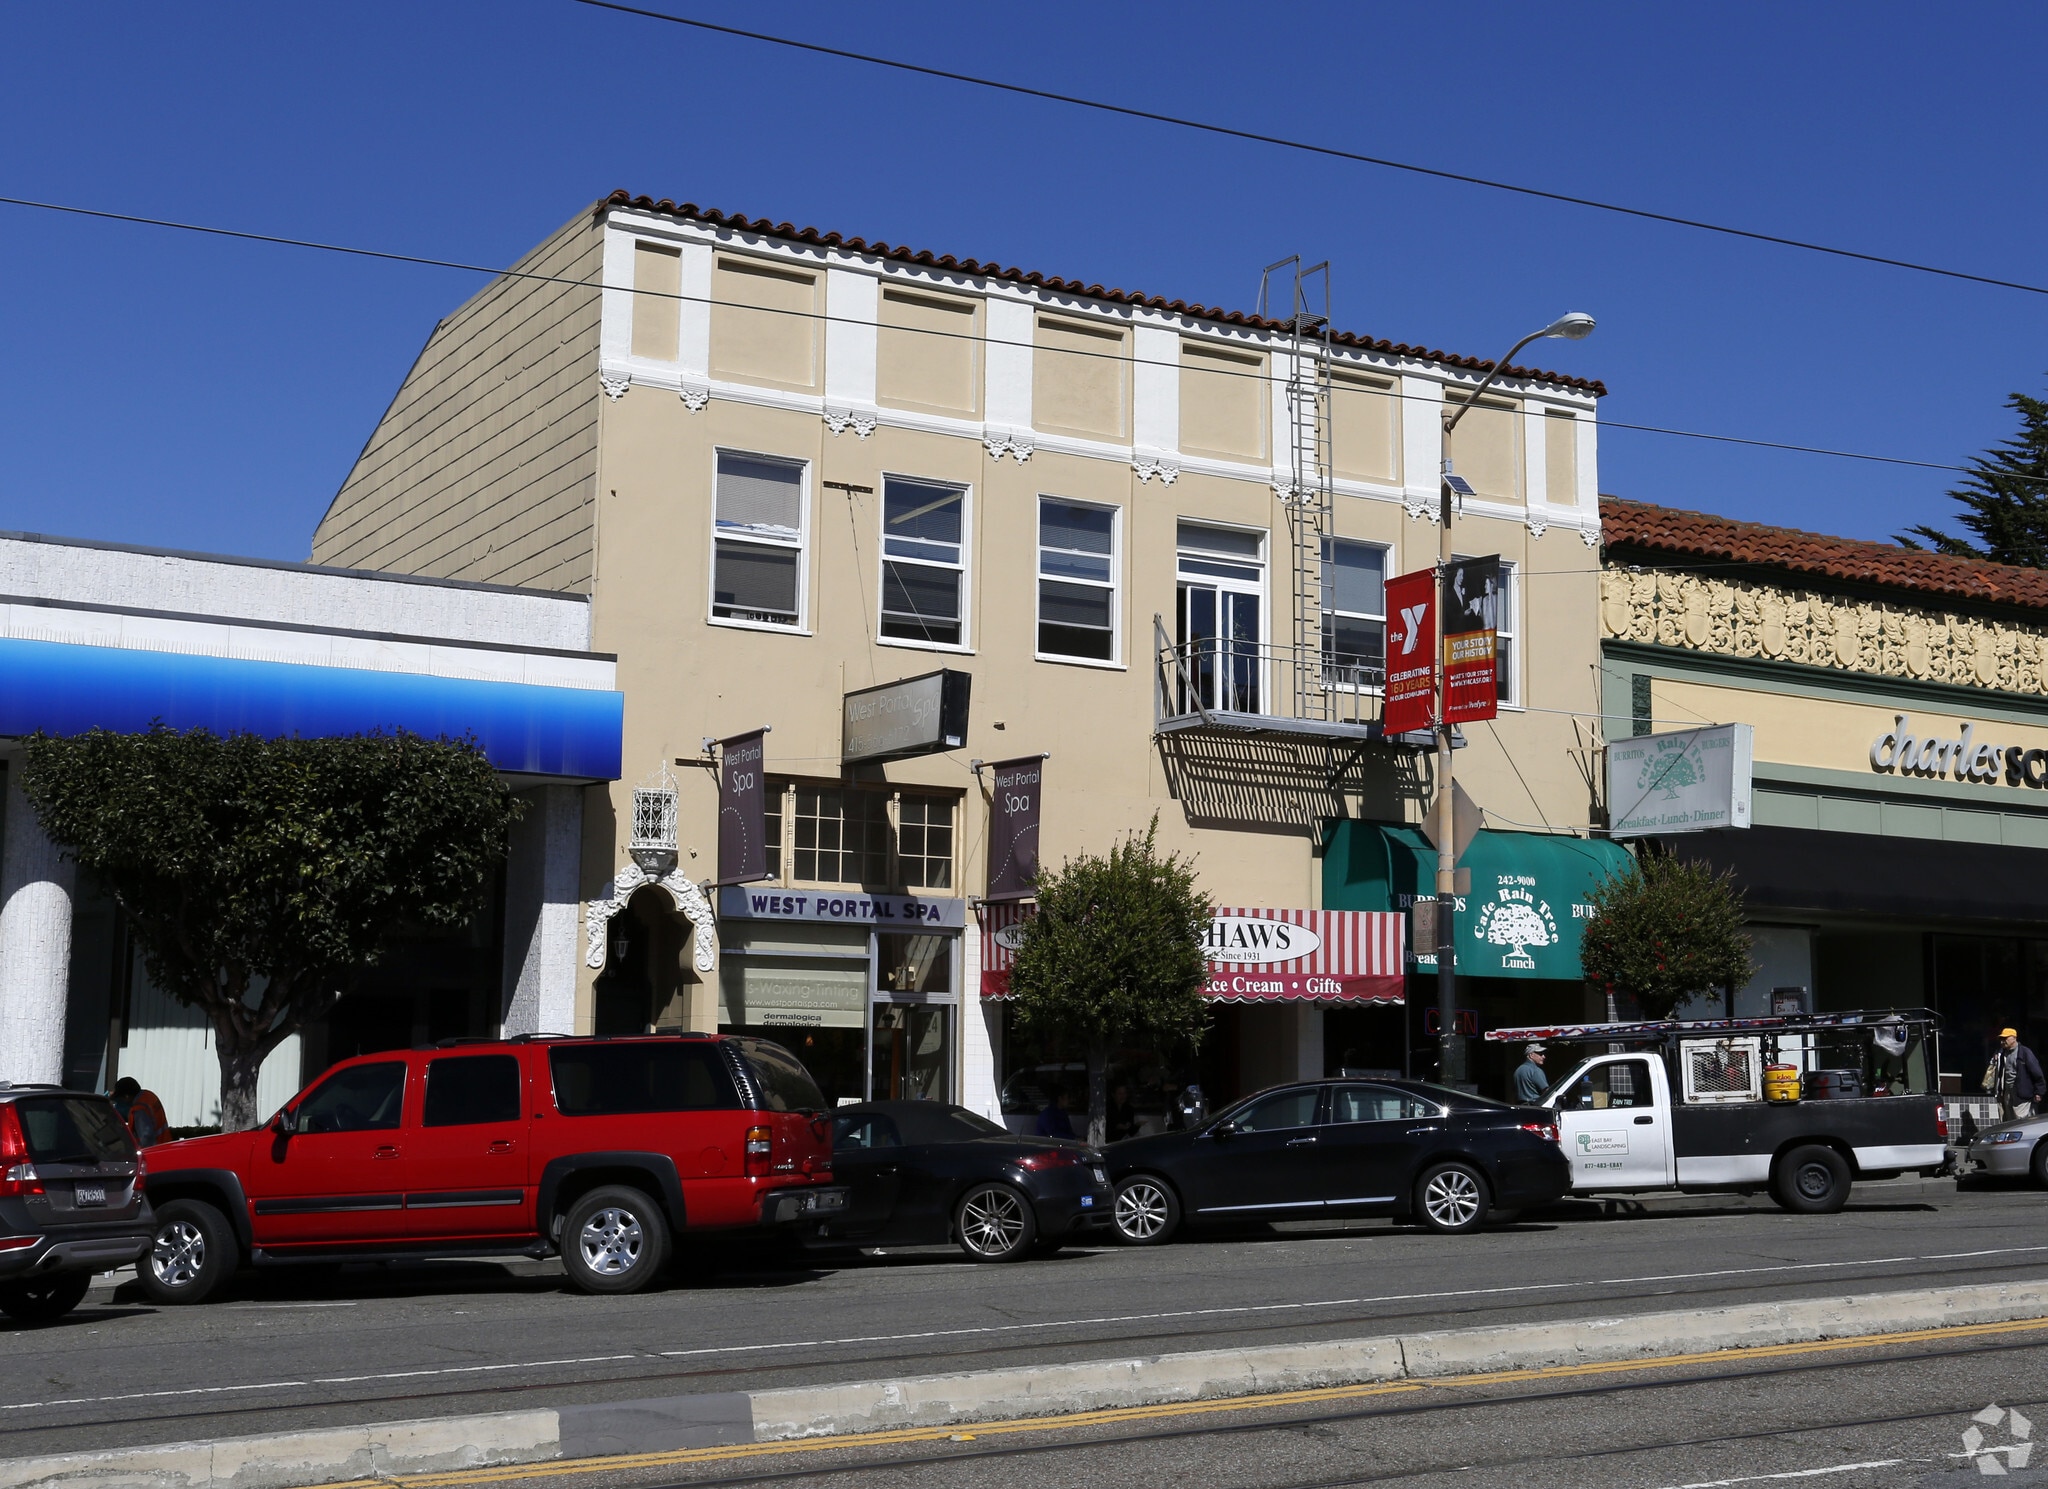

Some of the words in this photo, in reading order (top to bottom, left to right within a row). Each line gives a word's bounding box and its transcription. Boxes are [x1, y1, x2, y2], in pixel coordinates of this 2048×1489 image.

[1391, 632, 1403, 642] the
[1452, 640, 1469, 650] YOUR
[1452, 651, 1464, 660] OUR
[1389, 666, 1430, 683] CELEBRATING
[1406, 677, 1431, 692] YEARS
[848, 701, 876, 722] West
[880, 690, 912, 714] Portal
[912, 691, 940, 728] Spa
[724, 751, 740, 766] West
[741, 745, 761, 762] Portal
[1614, 749, 1645, 762] BURRITOS
[1869, 714, 2004, 785] charles
[1637, 753, 1654, 789] Cafe
[1656, 737, 1687, 752] Rain
[1690, 745, 1706, 782] Tree
[732, 770, 753, 797] Spa
[996, 773, 1014, 787] West
[1015, 770, 1039, 785] Portal
[1005, 792, 1029, 817] Spa
[1617, 816, 1656, 830] Breakfast
[1661, 812, 1688, 825] Lunch
[1694, 809, 1725, 821] Dinner
[1497, 875, 1536, 886] 242-9000
[752, 895, 807, 915] WEST
[817, 898, 895, 919] PORTAL
[903, 903, 941, 921] SPA
[1474, 901, 1496, 939] Cafe
[1498, 888, 1534, 904] Rain
[1538, 900, 1559, 944] Tree
[1220, 951, 1241, 960] Since
[1244, 952, 1260, 960] 1931
[1502, 956, 1535, 969] Lunch
[1232, 977, 1284, 992] Cream
[1306, 977, 1342, 994] Gifts
[764, 1012, 822, 1022] dermalogica
